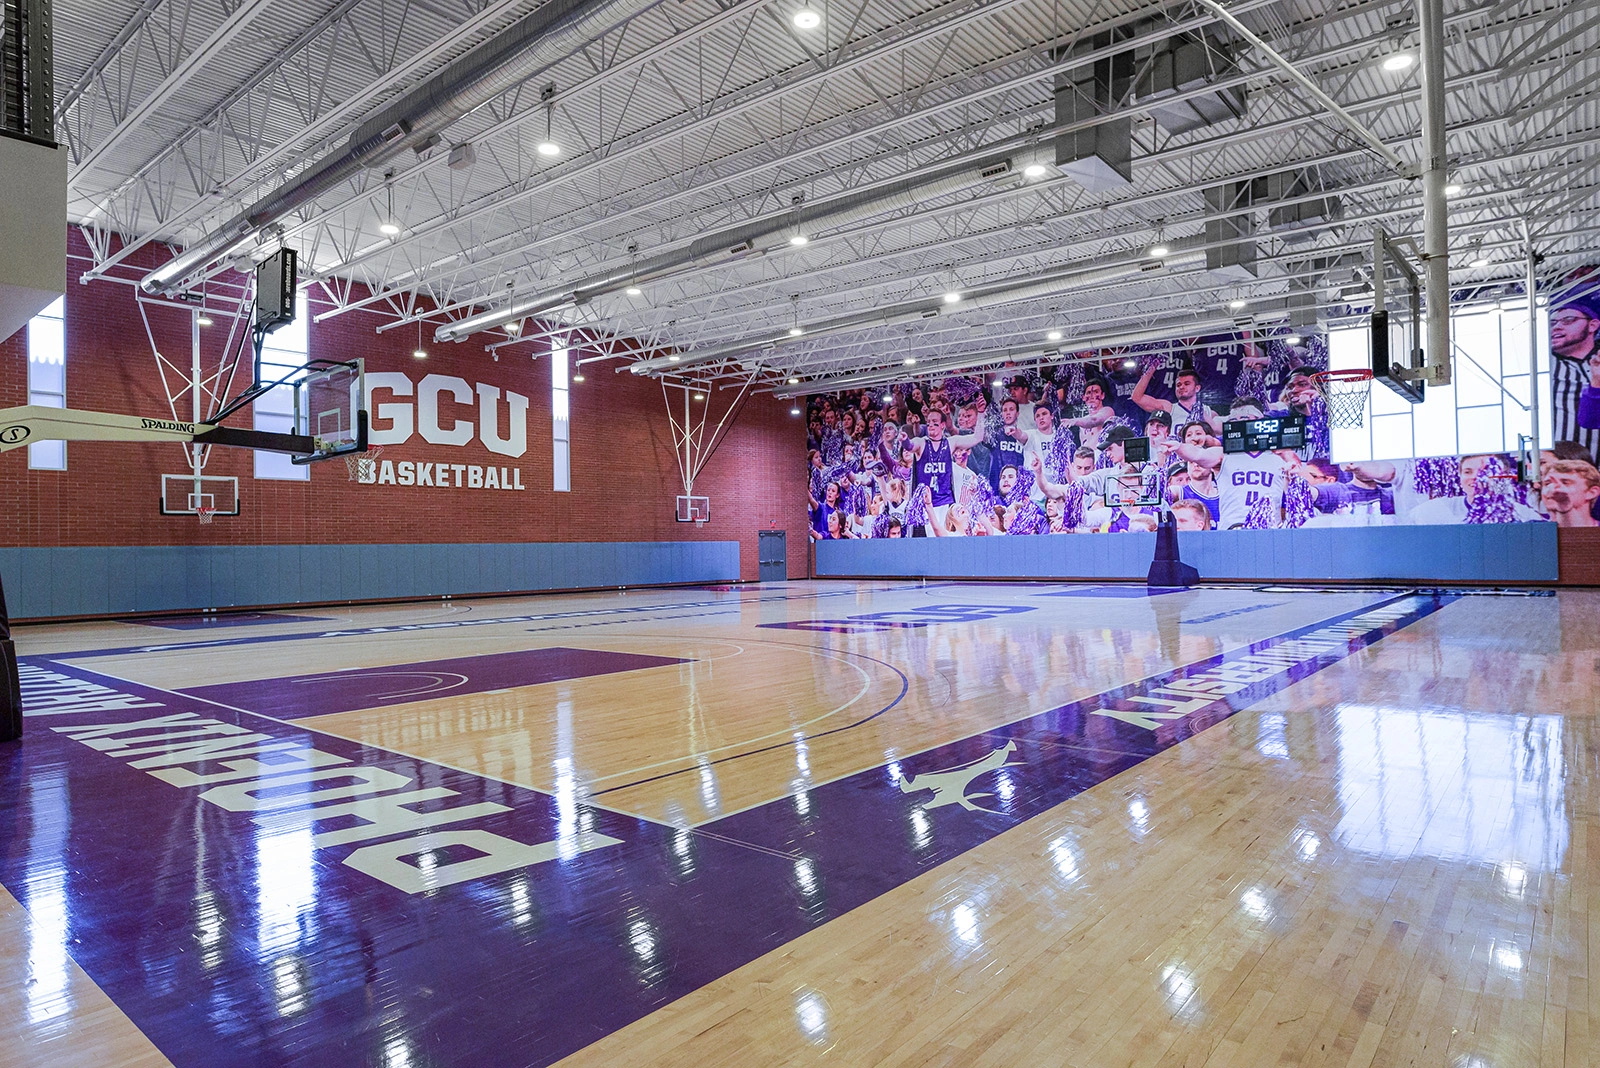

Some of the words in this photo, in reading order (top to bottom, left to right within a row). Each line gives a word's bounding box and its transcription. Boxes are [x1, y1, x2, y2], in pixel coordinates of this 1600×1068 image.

[1207, 344, 1238, 357] GCU
[1216, 359, 1228, 375] 4
[1163, 372, 1174, 388] 4
[350, 372, 529, 458] GCU
[141, 419, 195, 433] SPALDING
[1254, 420, 1279, 433] 9:52
[1000, 441, 1023, 453] GCU
[358, 459, 525, 490] BASKETBALL
[924, 462, 946, 473] GCU
[1232, 471, 1274, 487] GCU
[50, 712, 626, 894] PHOENIX
